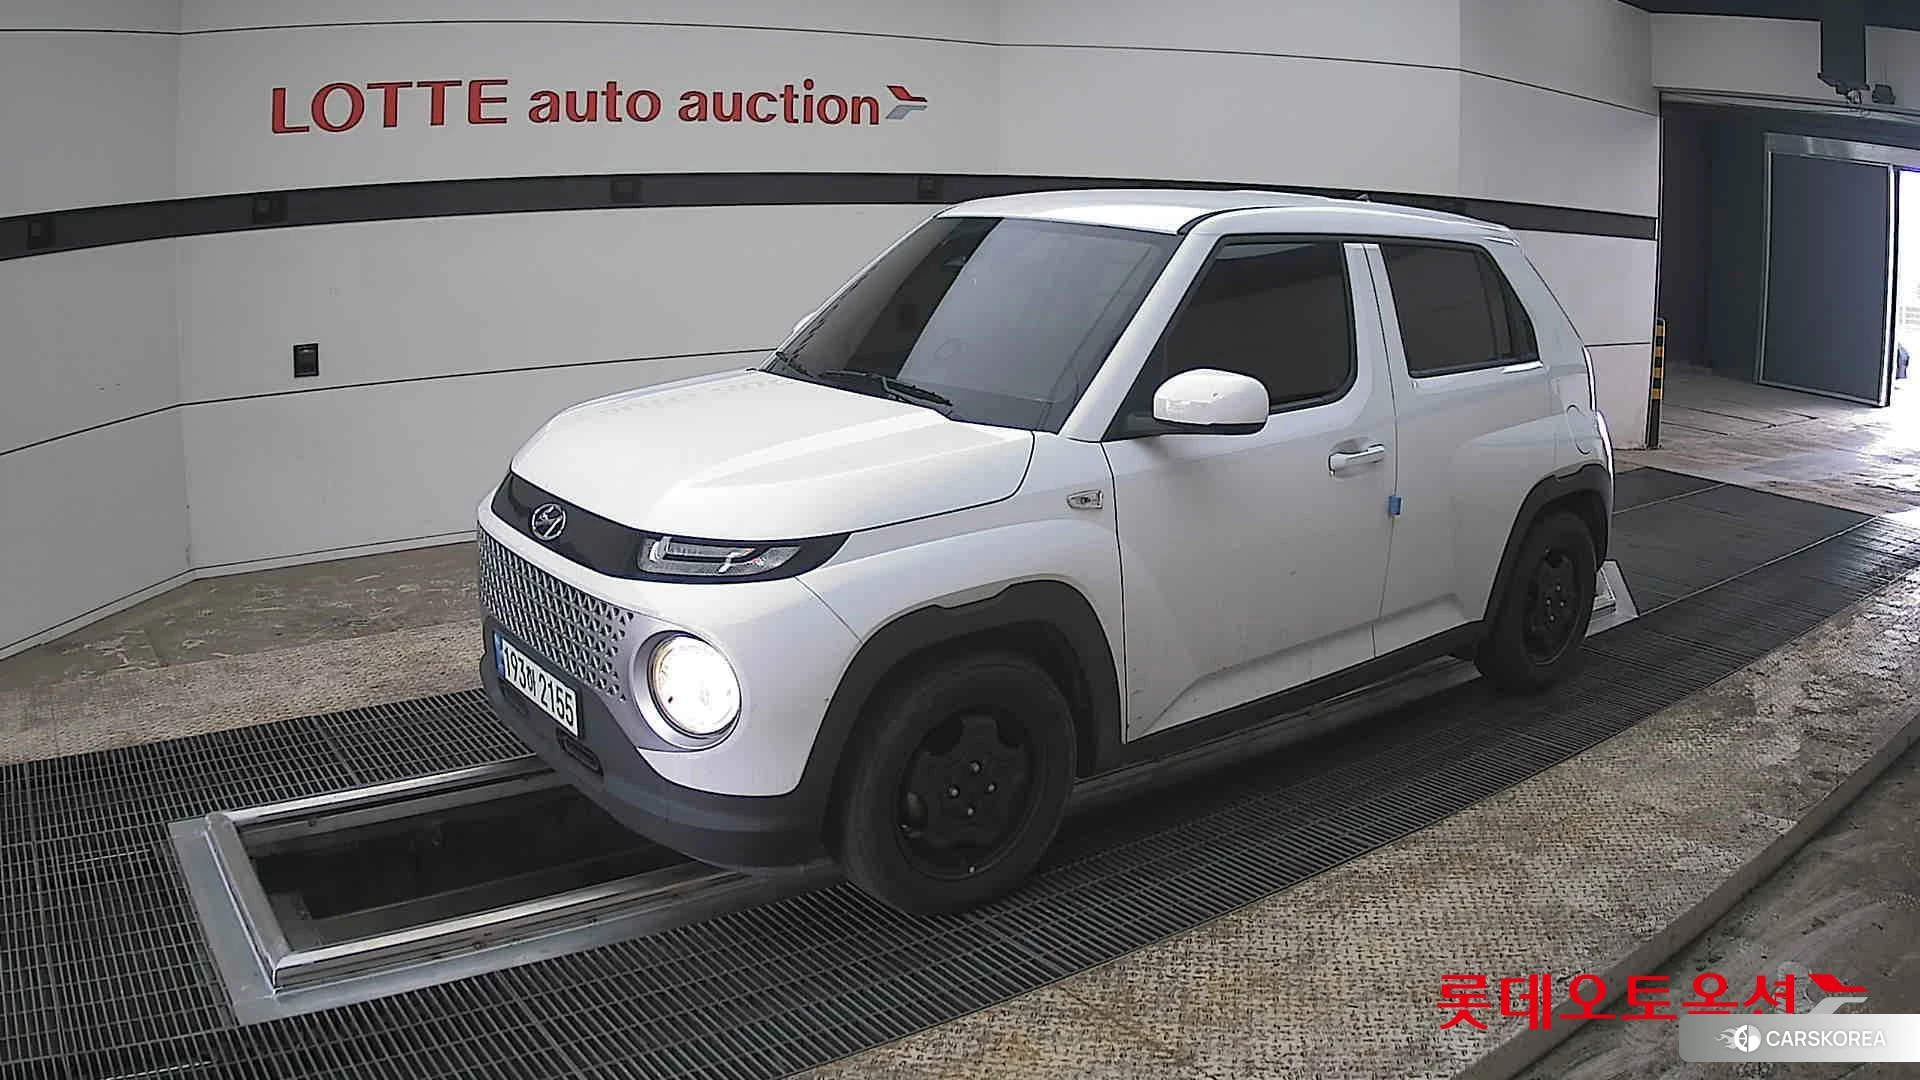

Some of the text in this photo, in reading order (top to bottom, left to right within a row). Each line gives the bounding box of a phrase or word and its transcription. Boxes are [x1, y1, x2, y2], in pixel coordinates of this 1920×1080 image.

[272, 78, 880, 134] LOTTE auto auction
[539, 672, 574, 726] 2155
